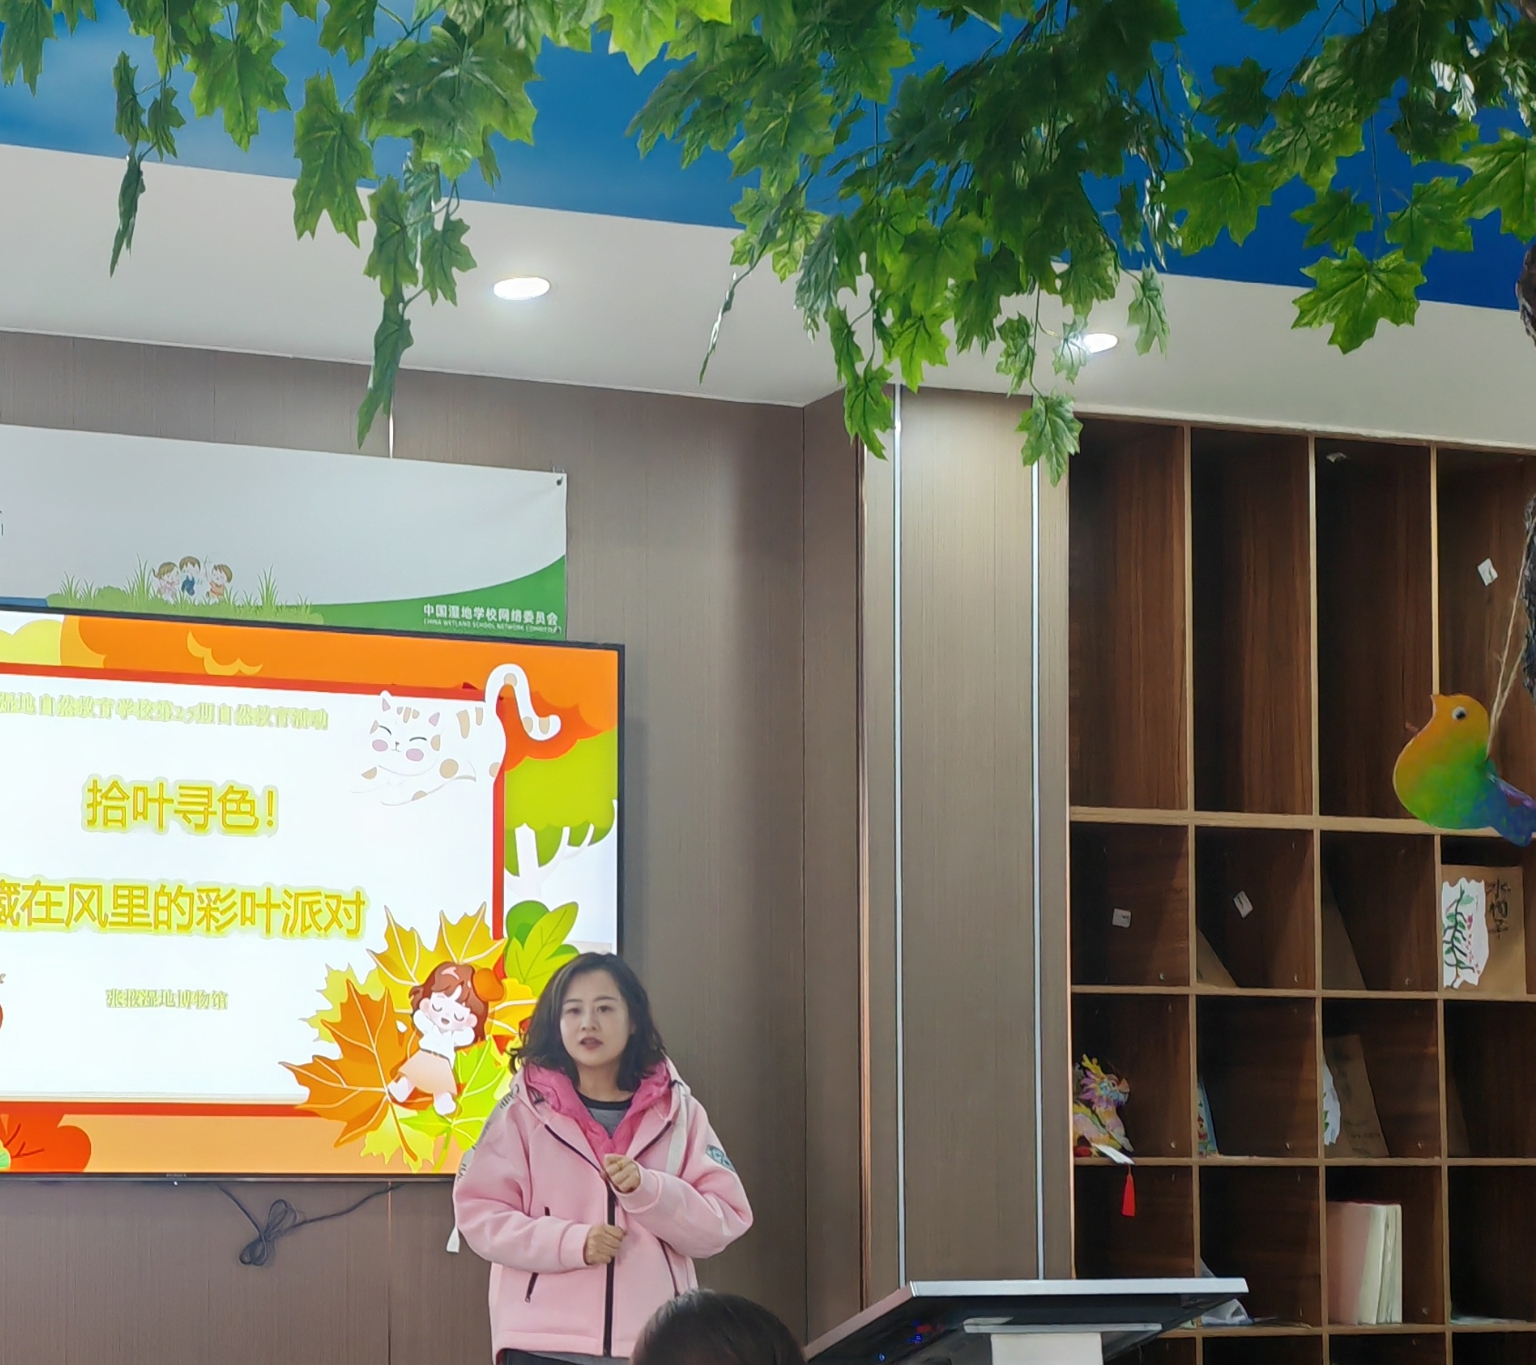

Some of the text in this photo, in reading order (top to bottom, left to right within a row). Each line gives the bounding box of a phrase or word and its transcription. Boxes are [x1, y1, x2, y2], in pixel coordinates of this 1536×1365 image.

[423, 603, 559, 626] 中国湿地学校网络委员会
